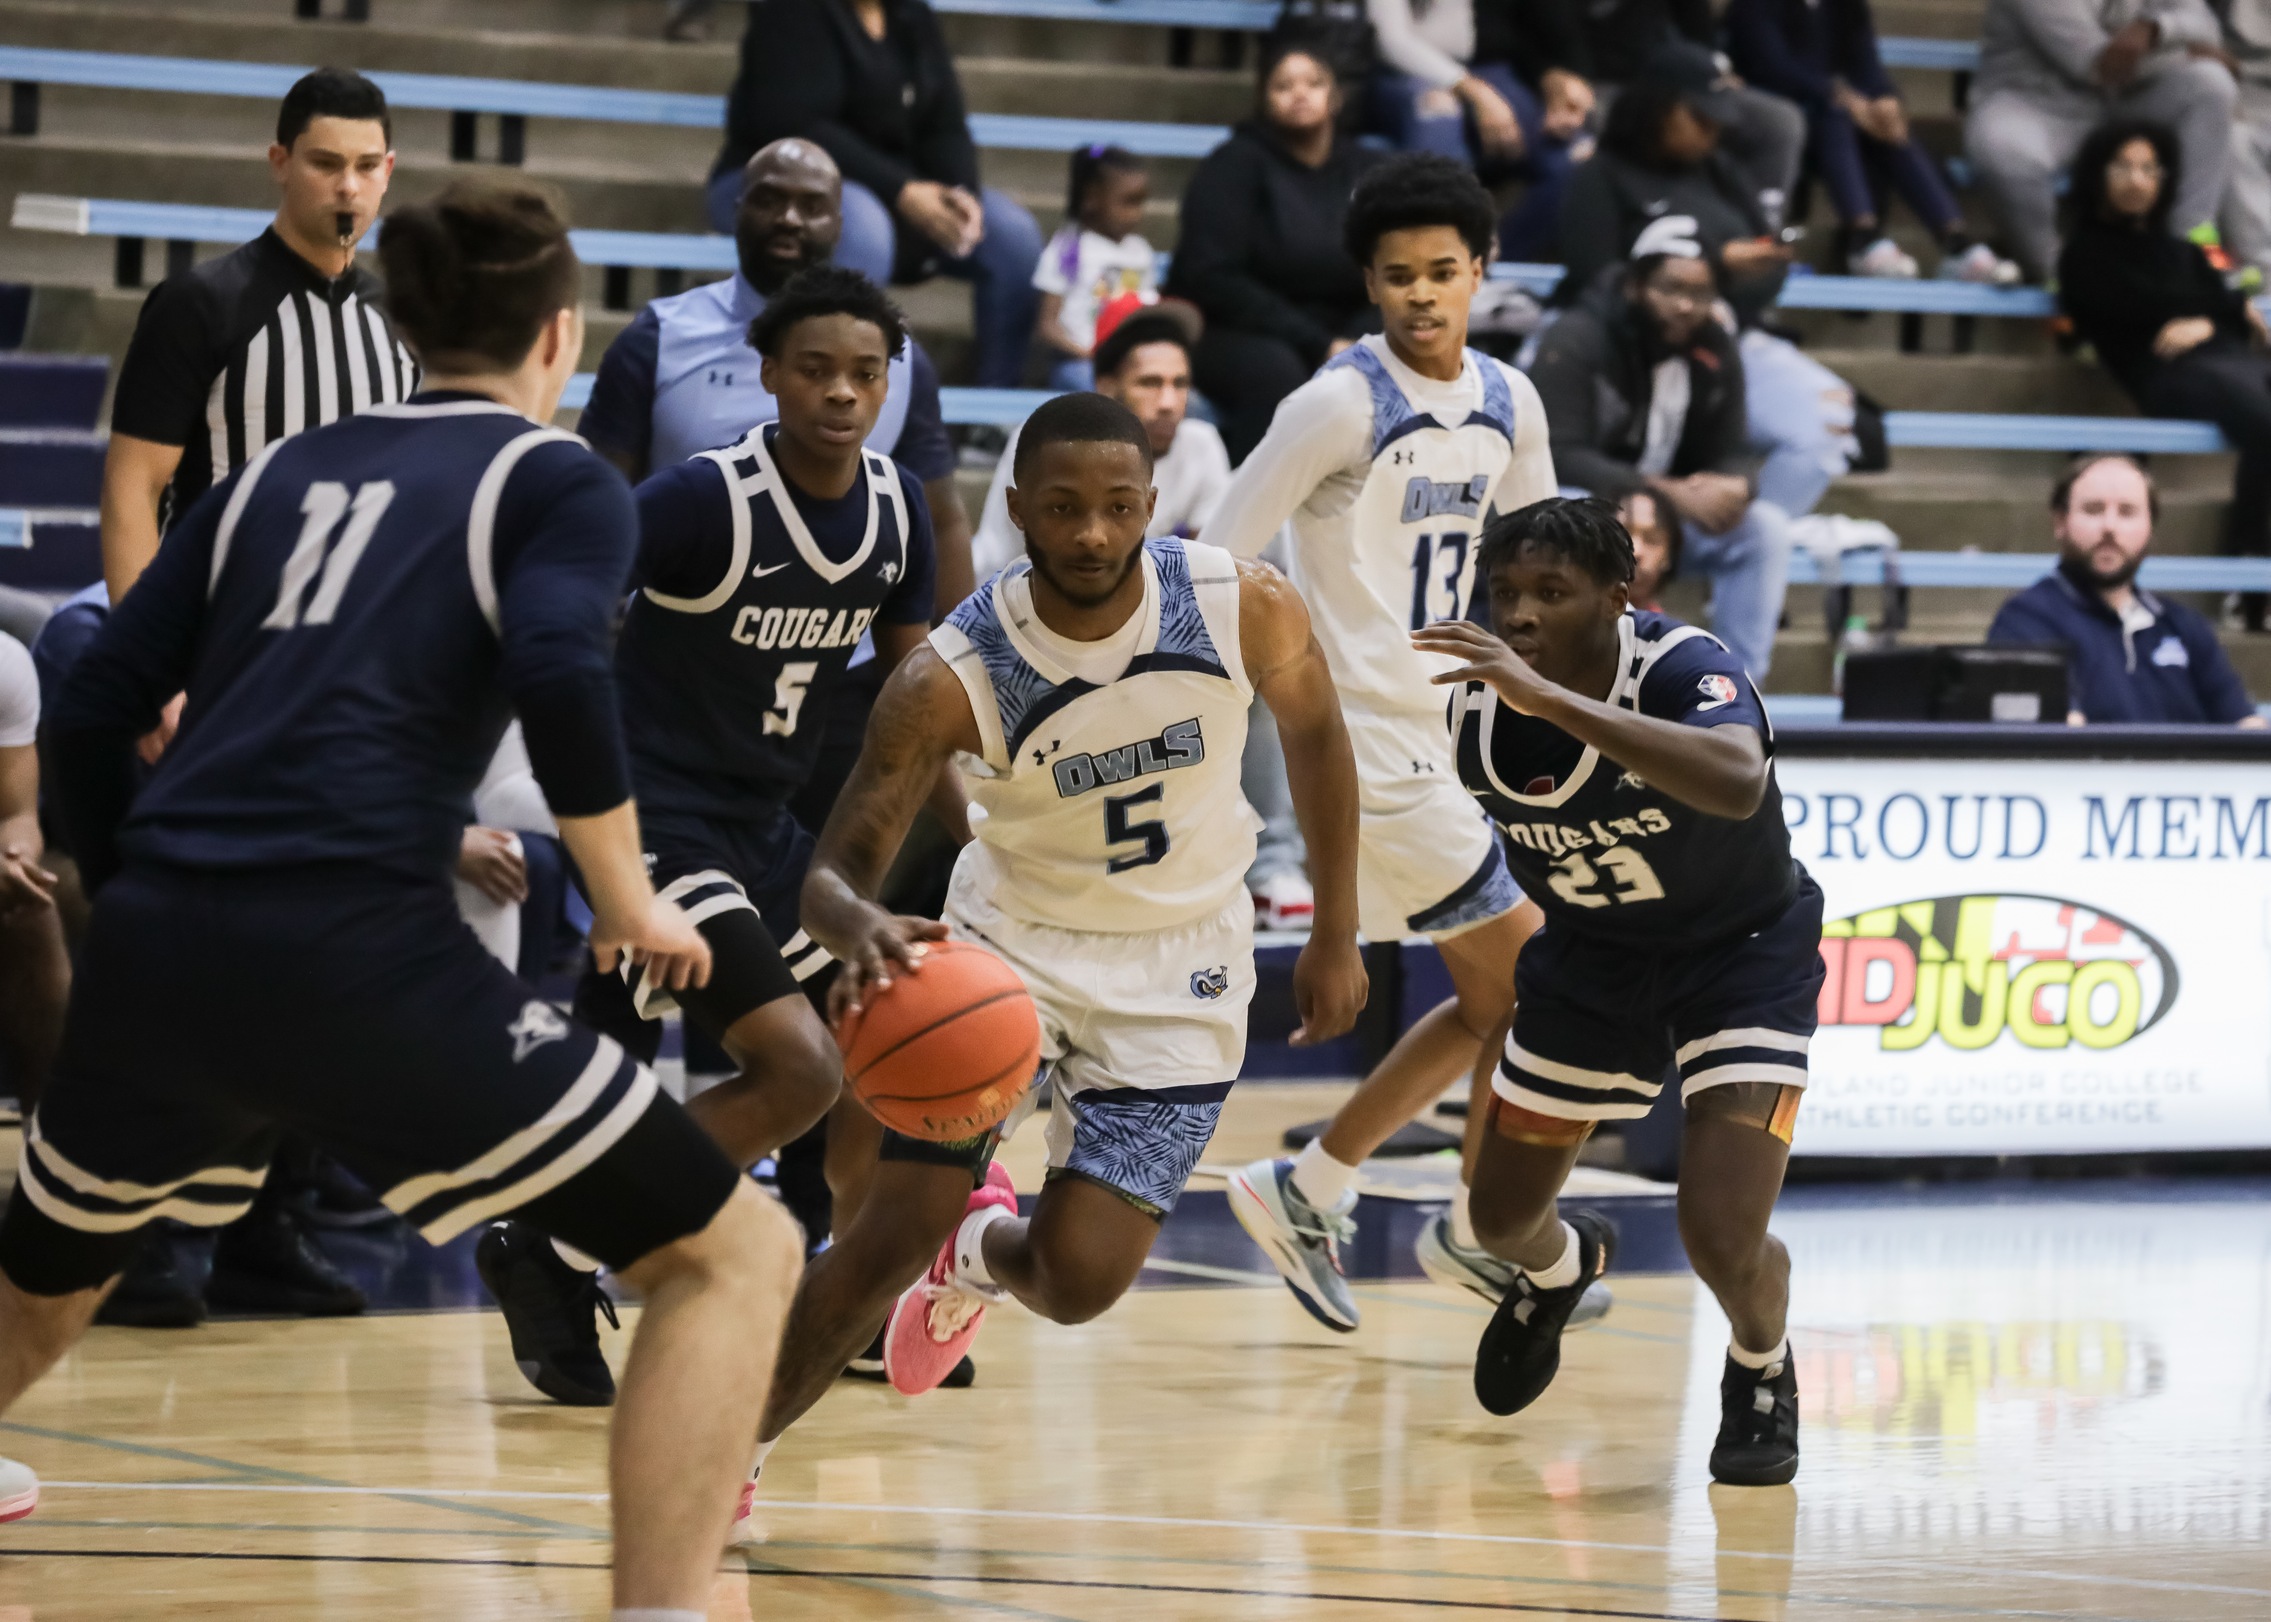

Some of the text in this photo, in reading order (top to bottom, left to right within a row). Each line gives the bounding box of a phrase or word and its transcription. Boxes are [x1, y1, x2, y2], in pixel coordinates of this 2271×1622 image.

[1400, 474, 1489, 524] OWLS
[260, 479, 397, 630] 11
[1410, 531, 1469, 632] 13
[730, 604, 880, 650] COUGAR
[762, 661, 819, 737] 5
[1052, 717, 1205, 799] OWLS
[1103, 781, 1171, 876] 5
[1496, 808, 1672, 857] OUGARS
[1547, 845, 1666, 909] 23
[1946, 1100, 2164, 1128] CONFERENCE
[2060, 1068, 2204, 1096] COLLEGE
